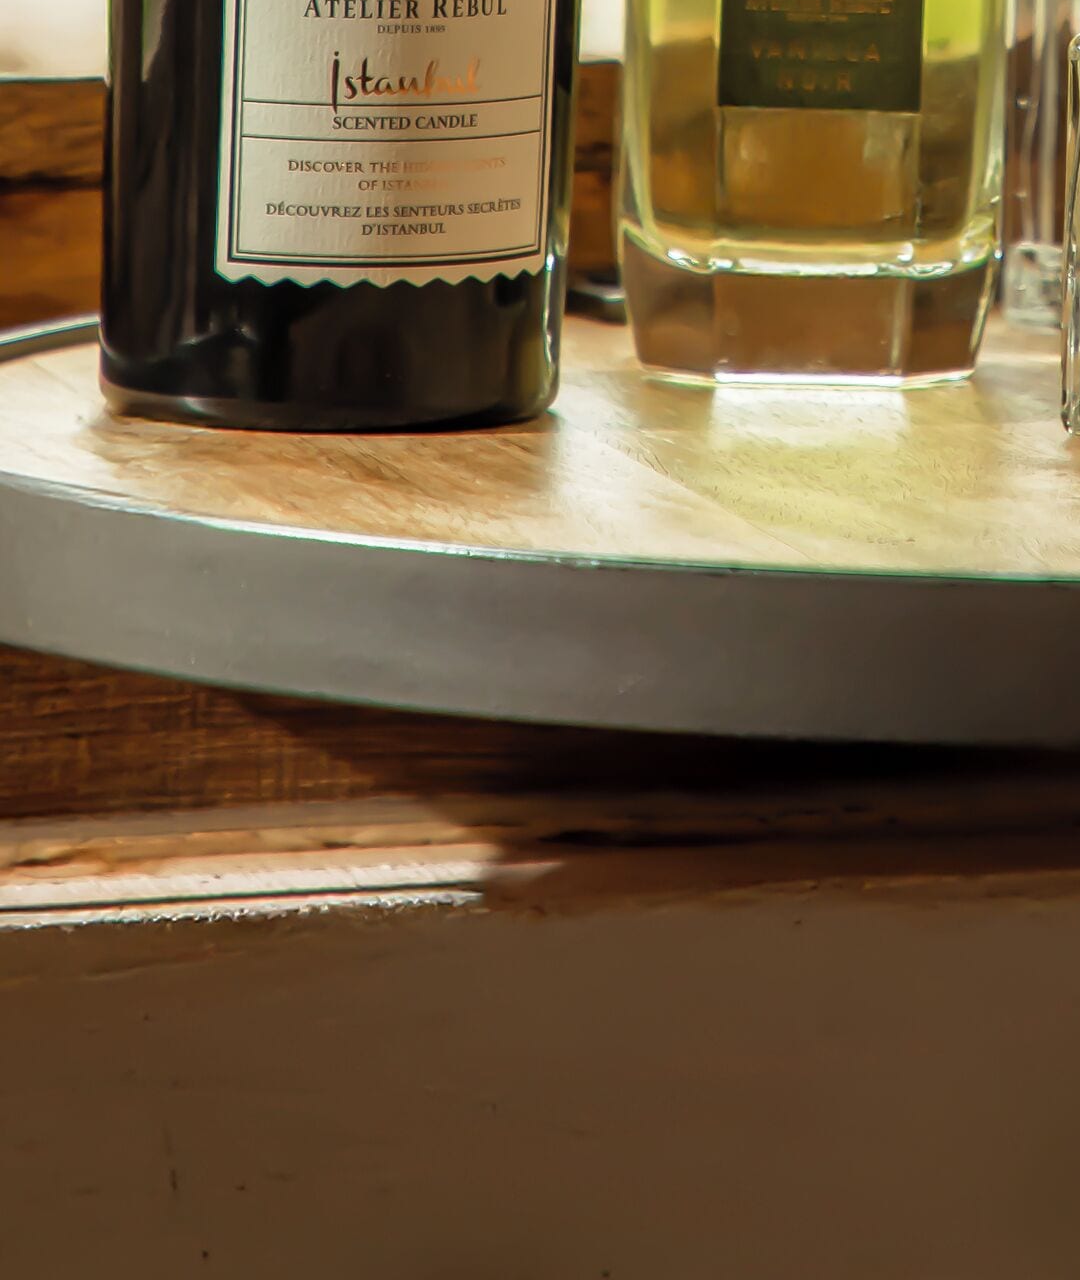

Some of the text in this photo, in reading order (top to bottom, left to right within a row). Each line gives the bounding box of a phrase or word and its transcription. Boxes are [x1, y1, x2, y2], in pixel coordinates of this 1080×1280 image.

[377, 24, 421, 34] DEPUIS
[332, 114, 478, 130] SCENTED CANDLE
[288, 159, 364, 173] DISCOVER
[369, 161, 400, 173] THE
[358, 180, 377, 191] OF
[266, 198, 521, 218] DÉCOUVREZ LES SENTEURS SECRÈTES
